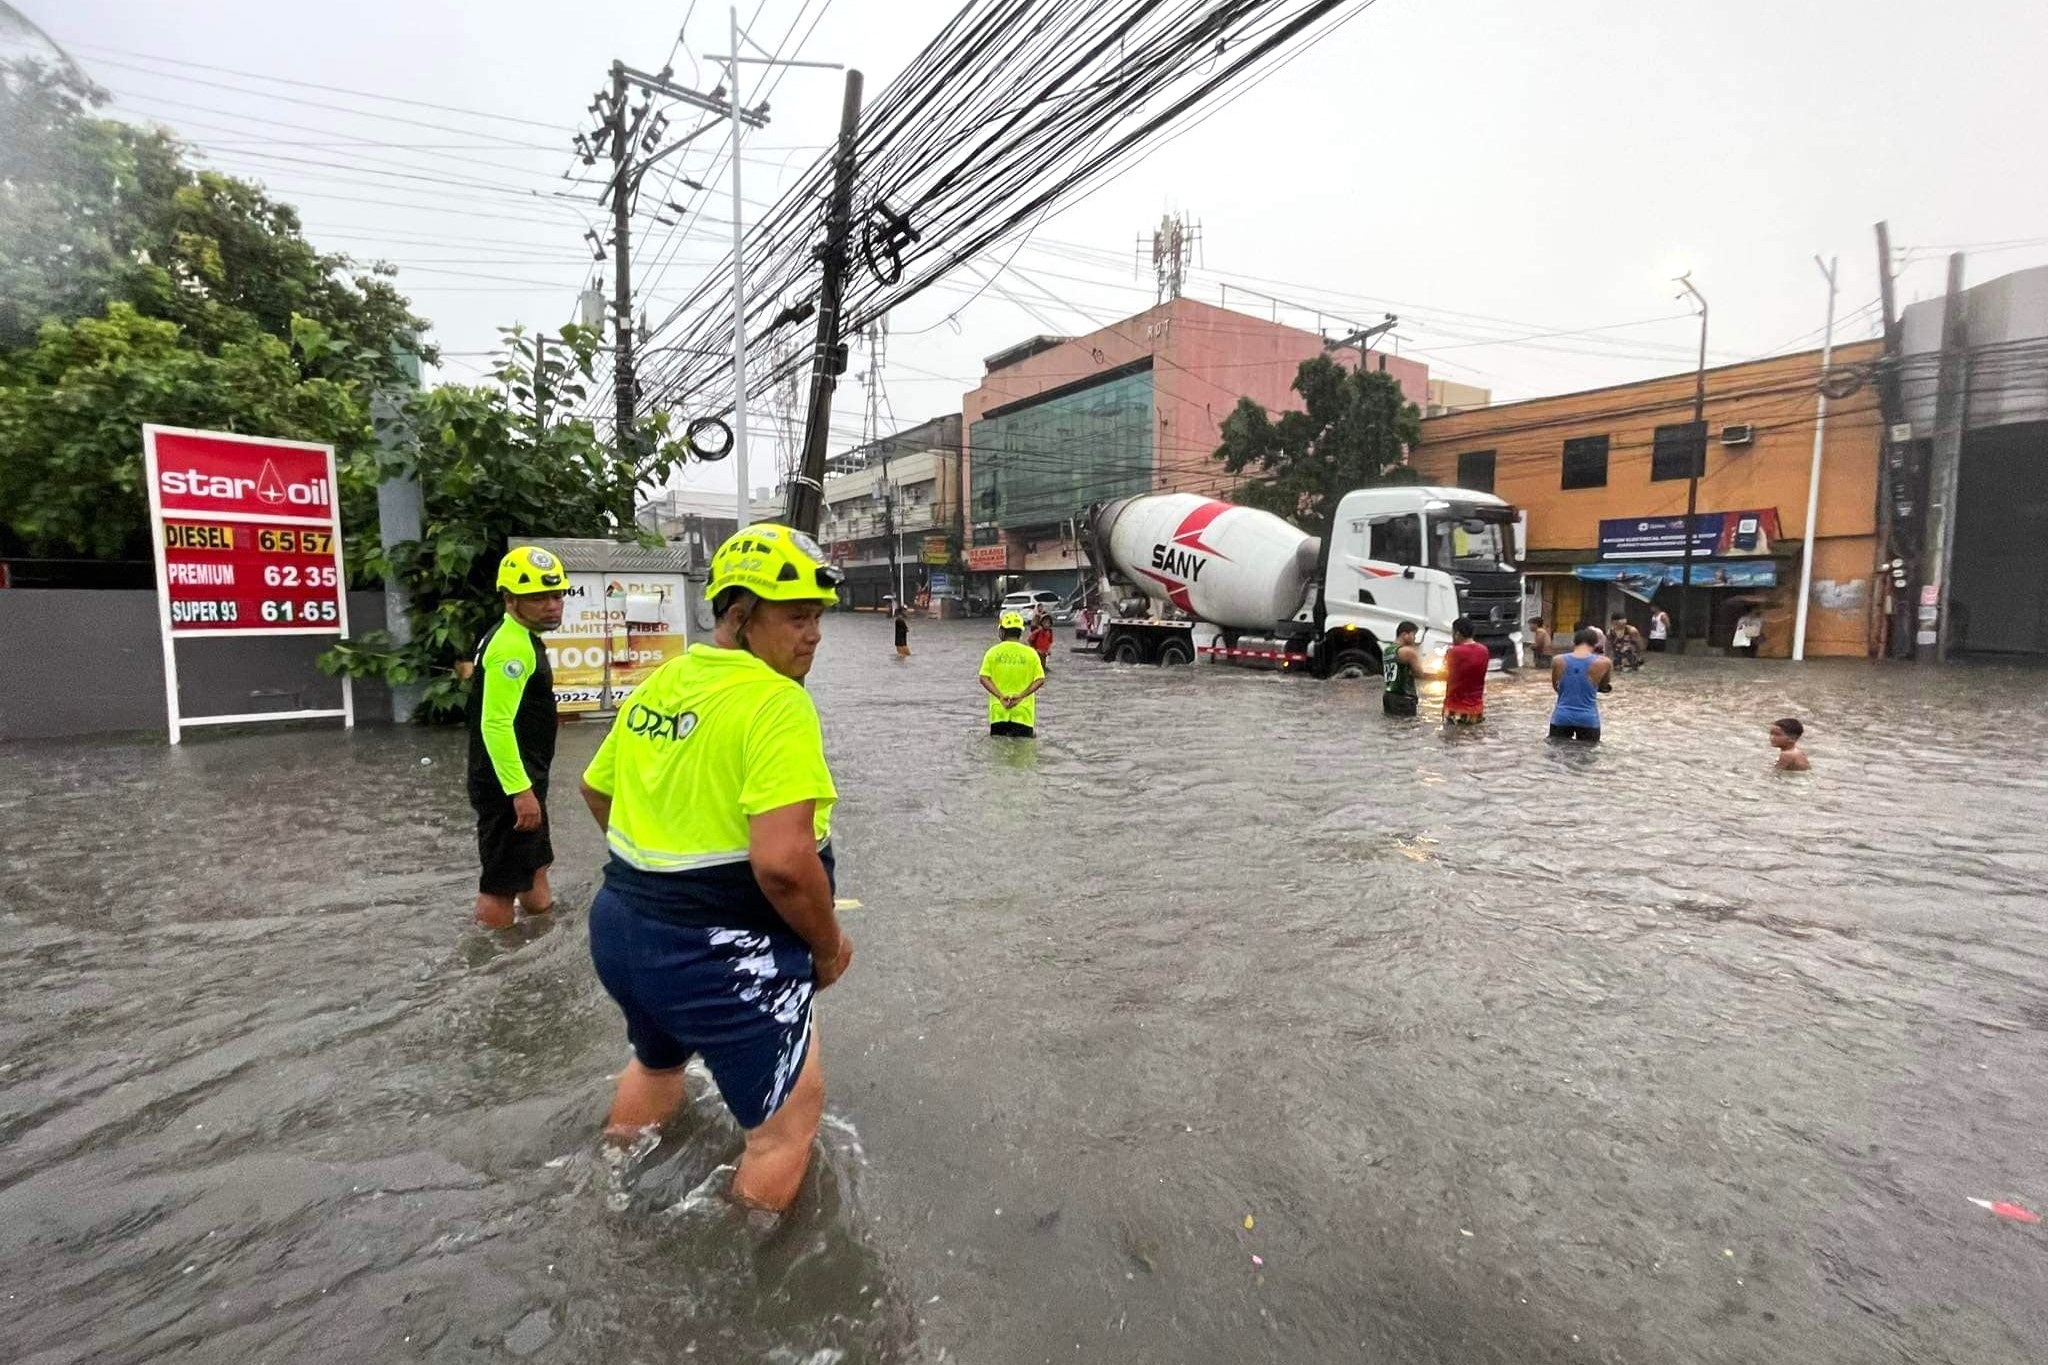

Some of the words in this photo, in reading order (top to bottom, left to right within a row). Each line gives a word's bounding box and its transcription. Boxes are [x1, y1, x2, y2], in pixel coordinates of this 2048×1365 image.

[161, 469, 256, 499] star
[288, 478, 329, 505] oil
[166, 525, 231, 548] DIESEL
[1151, 543, 1207, 582] SANY
[168, 564, 235, 585] PREMIUM
[562, 585, 585, 597] 64
[173, 601, 217, 622] SUPER
[221, 601, 238, 622] 93
[546, 646, 605, 668] 100
